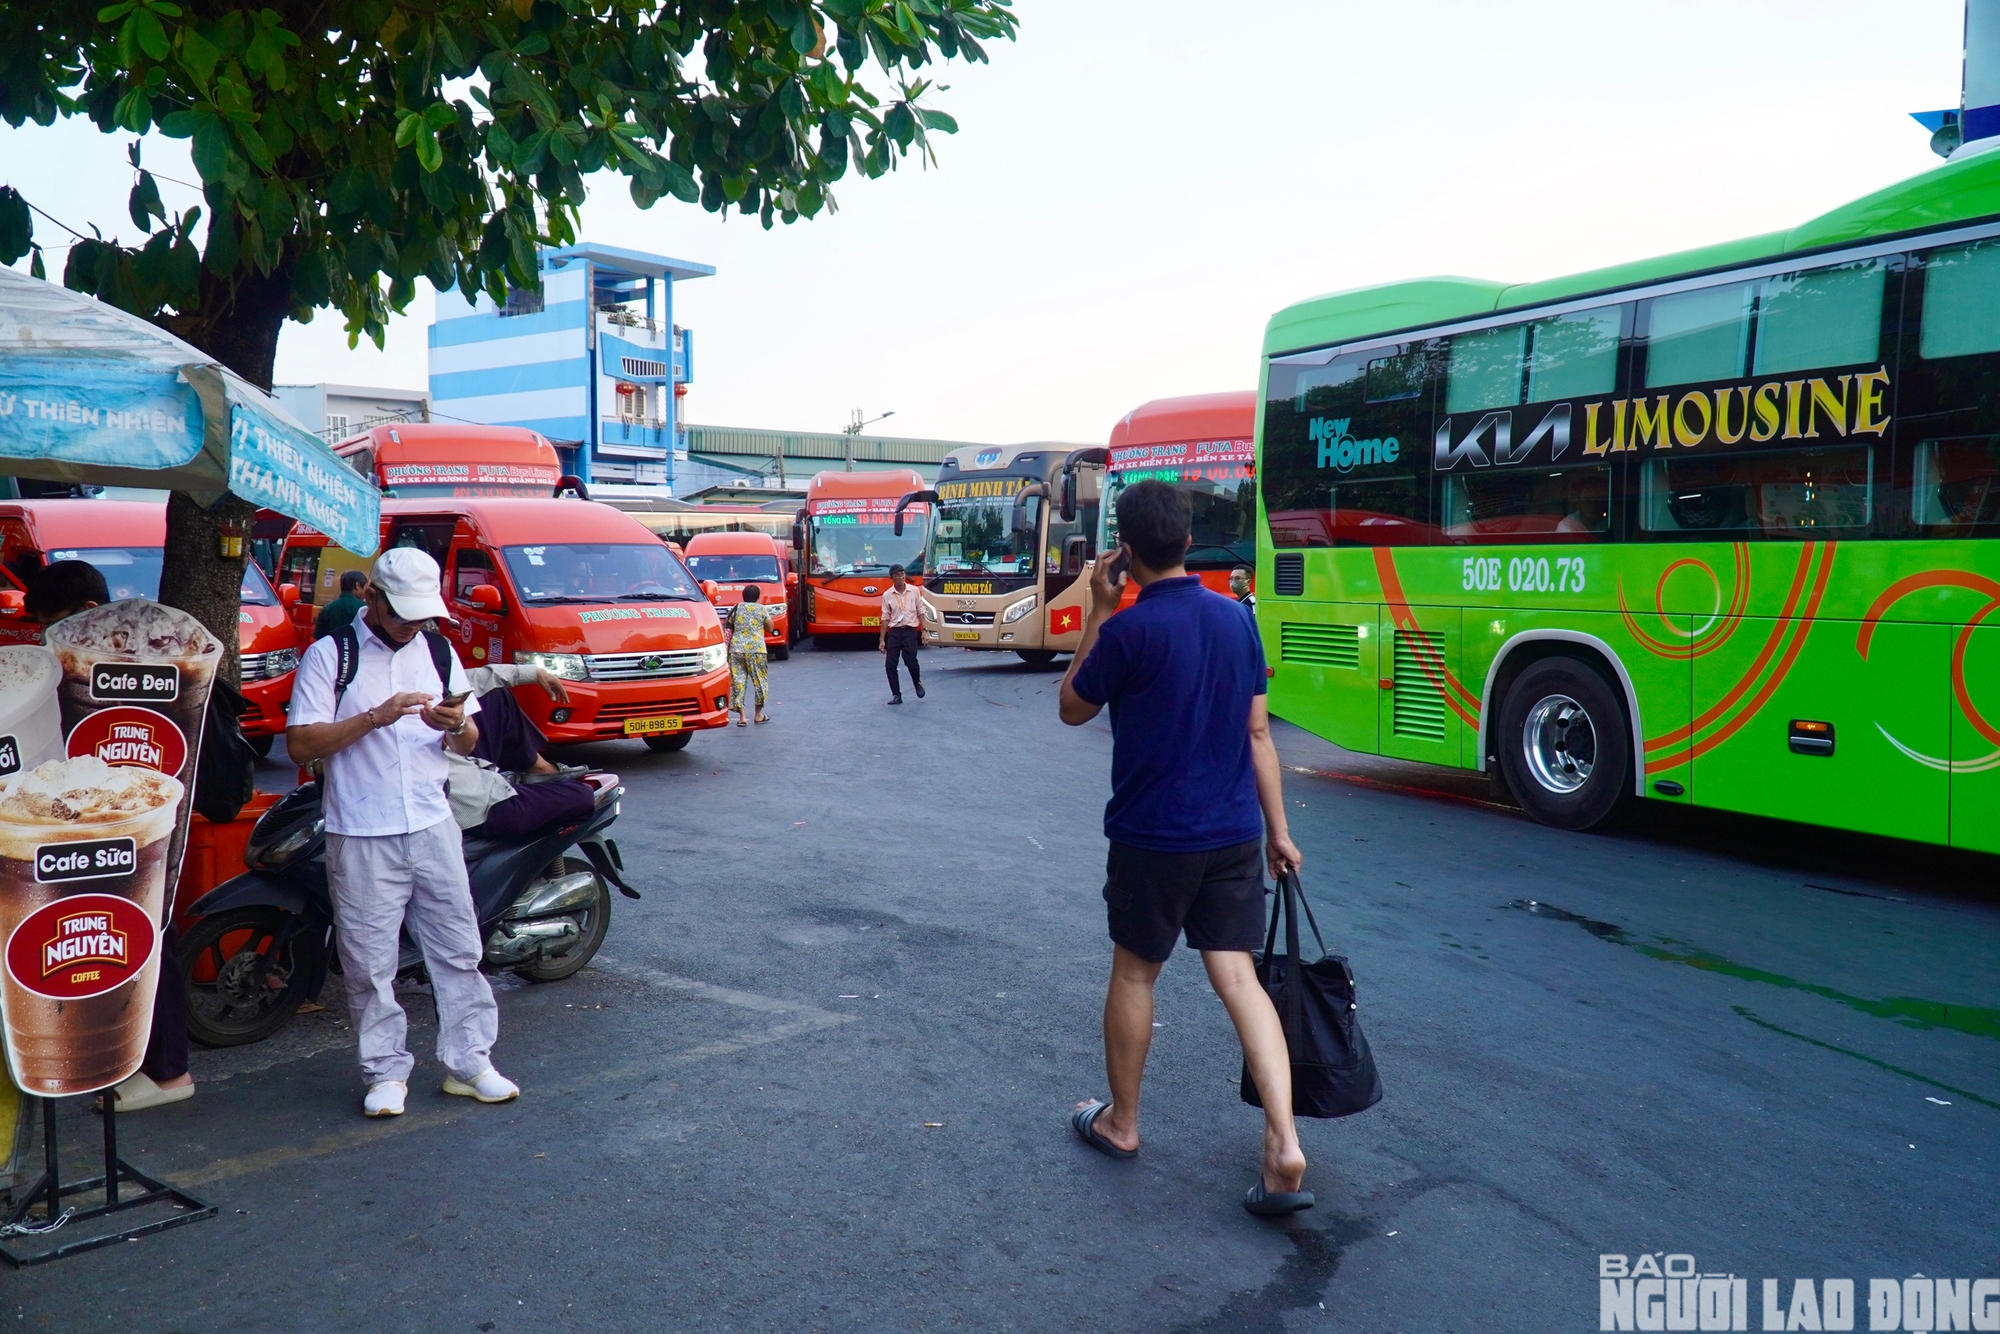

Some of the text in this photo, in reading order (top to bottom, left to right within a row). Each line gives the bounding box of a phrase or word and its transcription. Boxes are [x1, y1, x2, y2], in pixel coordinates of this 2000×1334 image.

[1434, 365, 1891, 470] KIA LIMOUSINE
[1309, 416, 1351, 441] New
[1111, 447, 1149, 462] PHƯƠNG
[1151, 444, 1187, 457] TRANG
[1197, 442, 1232, 454] FUTA
[1162, 457, 1185, 465] TÂY
[1195, 454, 1218, 463] BẾN
[1317, 434, 1400, 473] Home
[387, 464, 430, 476] PHƯƠNG
[432, 465, 469, 476] TRANG
[477, 466, 509, 477] FUTA
[938, 483, 967, 500] BÌNH
[969, 481, 1003, 497] MINH
[844, 499, 867, 507] TRANG
[1462, 556, 1586, 592] 50E 020.73
[943, 580, 960, 593] BÌNH
[961, 583, 979, 593] MINH
[578, 607, 690, 623] PHƯƠNG TRANG
[97, 672, 175, 691] Cafe Đen
[113, 726, 149, 741] TRUNG
[629, 718, 678, 731] 50H-898.55
[99, 741, 160, 766] NGUYÊN
[39, 848, 132, 873] Cafe Sữa
[62, 916, 107, 936] TRUNG
[47, 932, 124, 967] NGUYÊN
[71, 970, 100, 984] COFFEE
